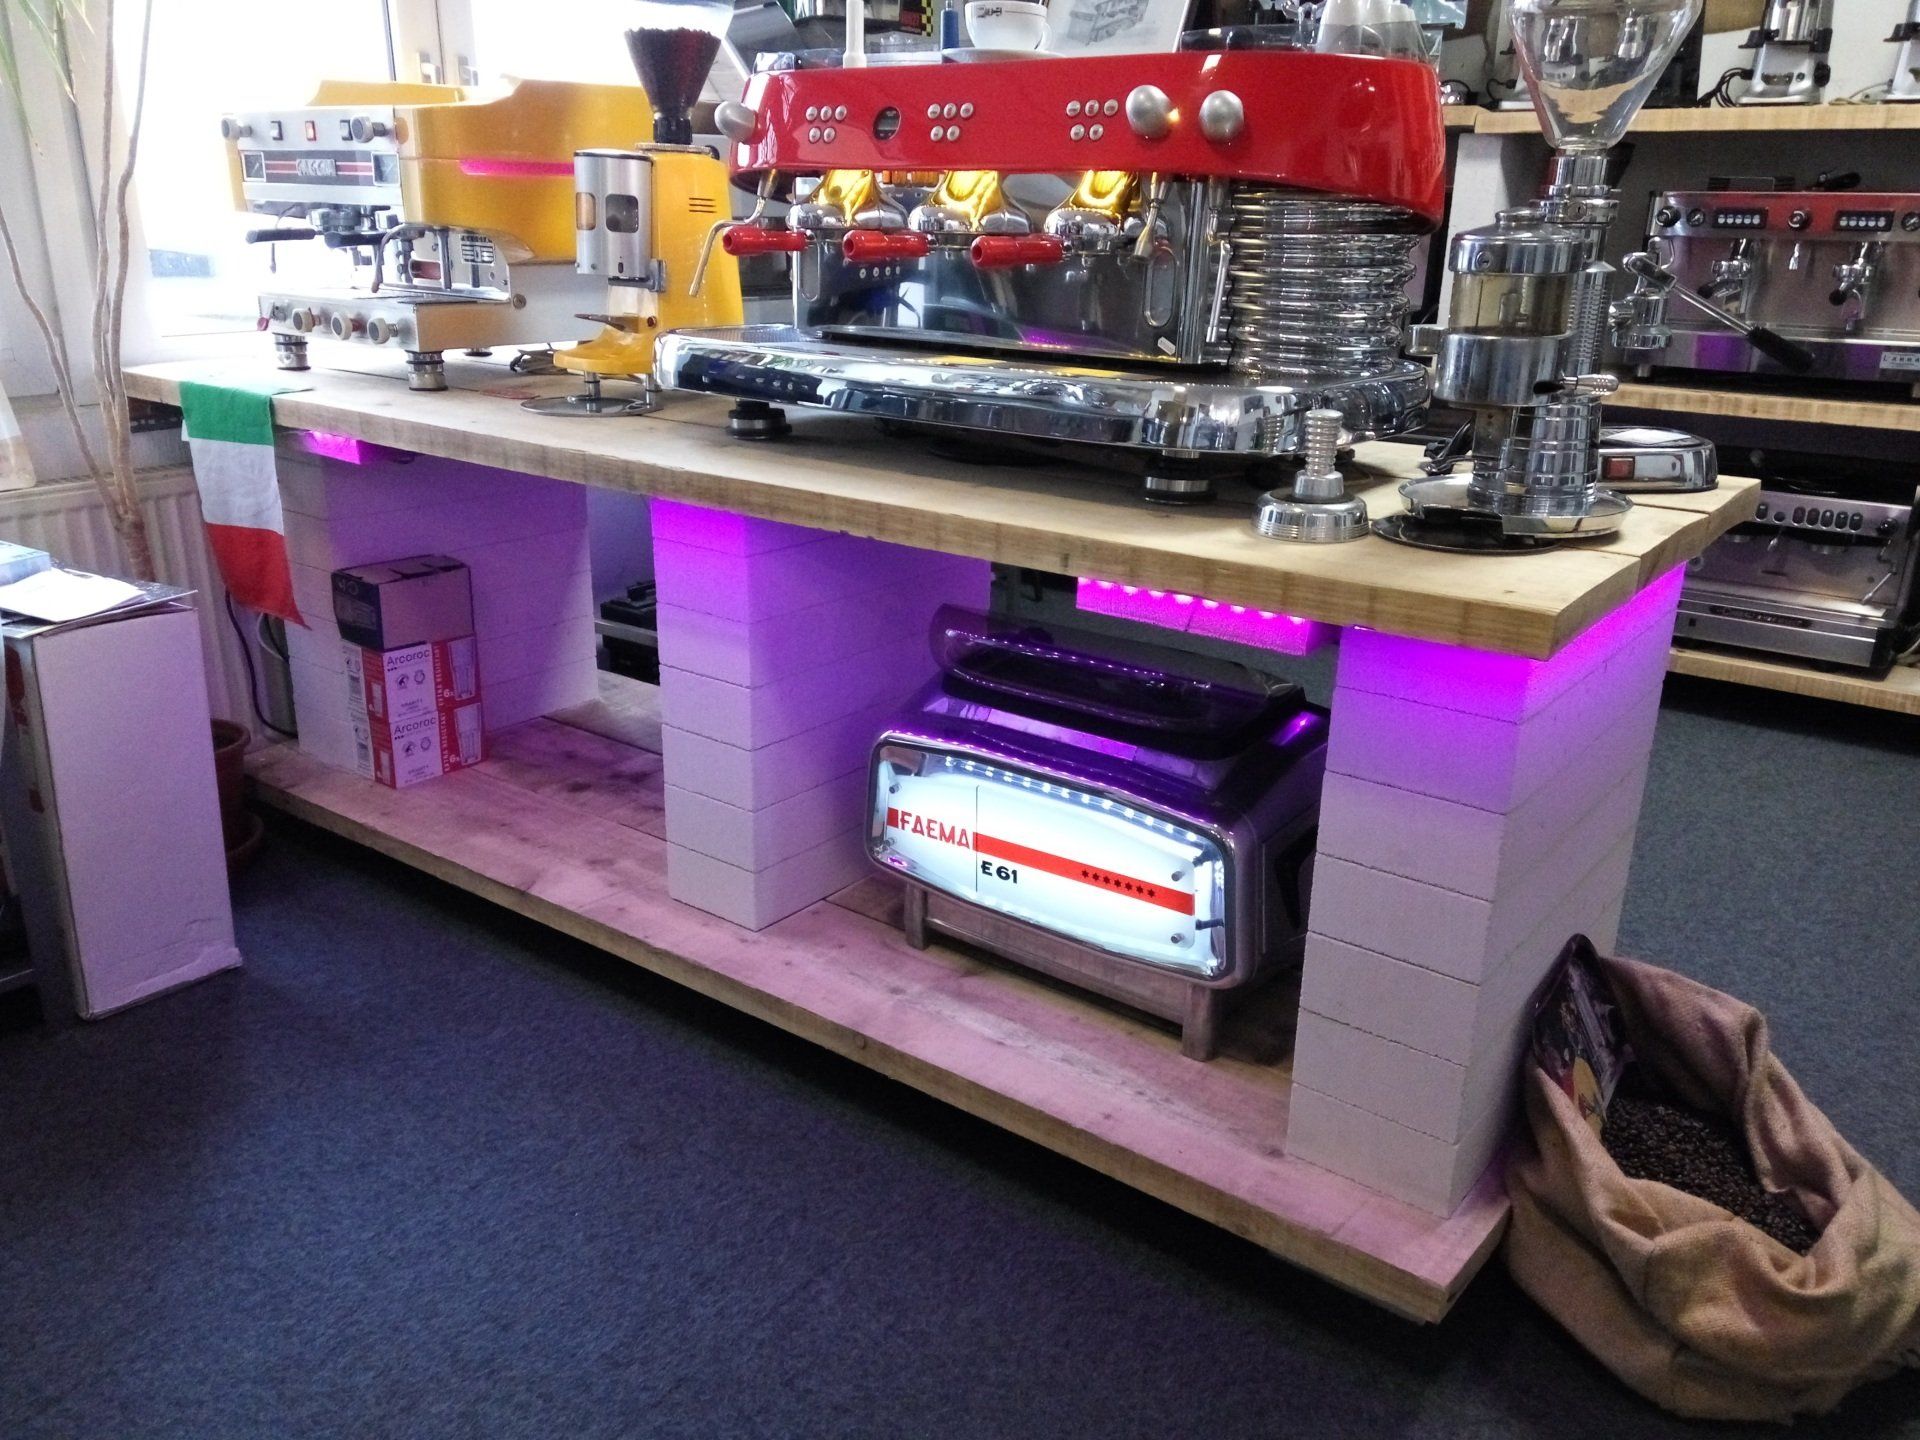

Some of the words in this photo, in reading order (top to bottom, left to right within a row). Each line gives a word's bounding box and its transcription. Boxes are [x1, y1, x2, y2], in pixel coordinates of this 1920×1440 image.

[386, 648, 430, 667] Arcoroc
[393, 715, 436, 736] Arcoroc
[900, 810, 971, 849] FAEMA
